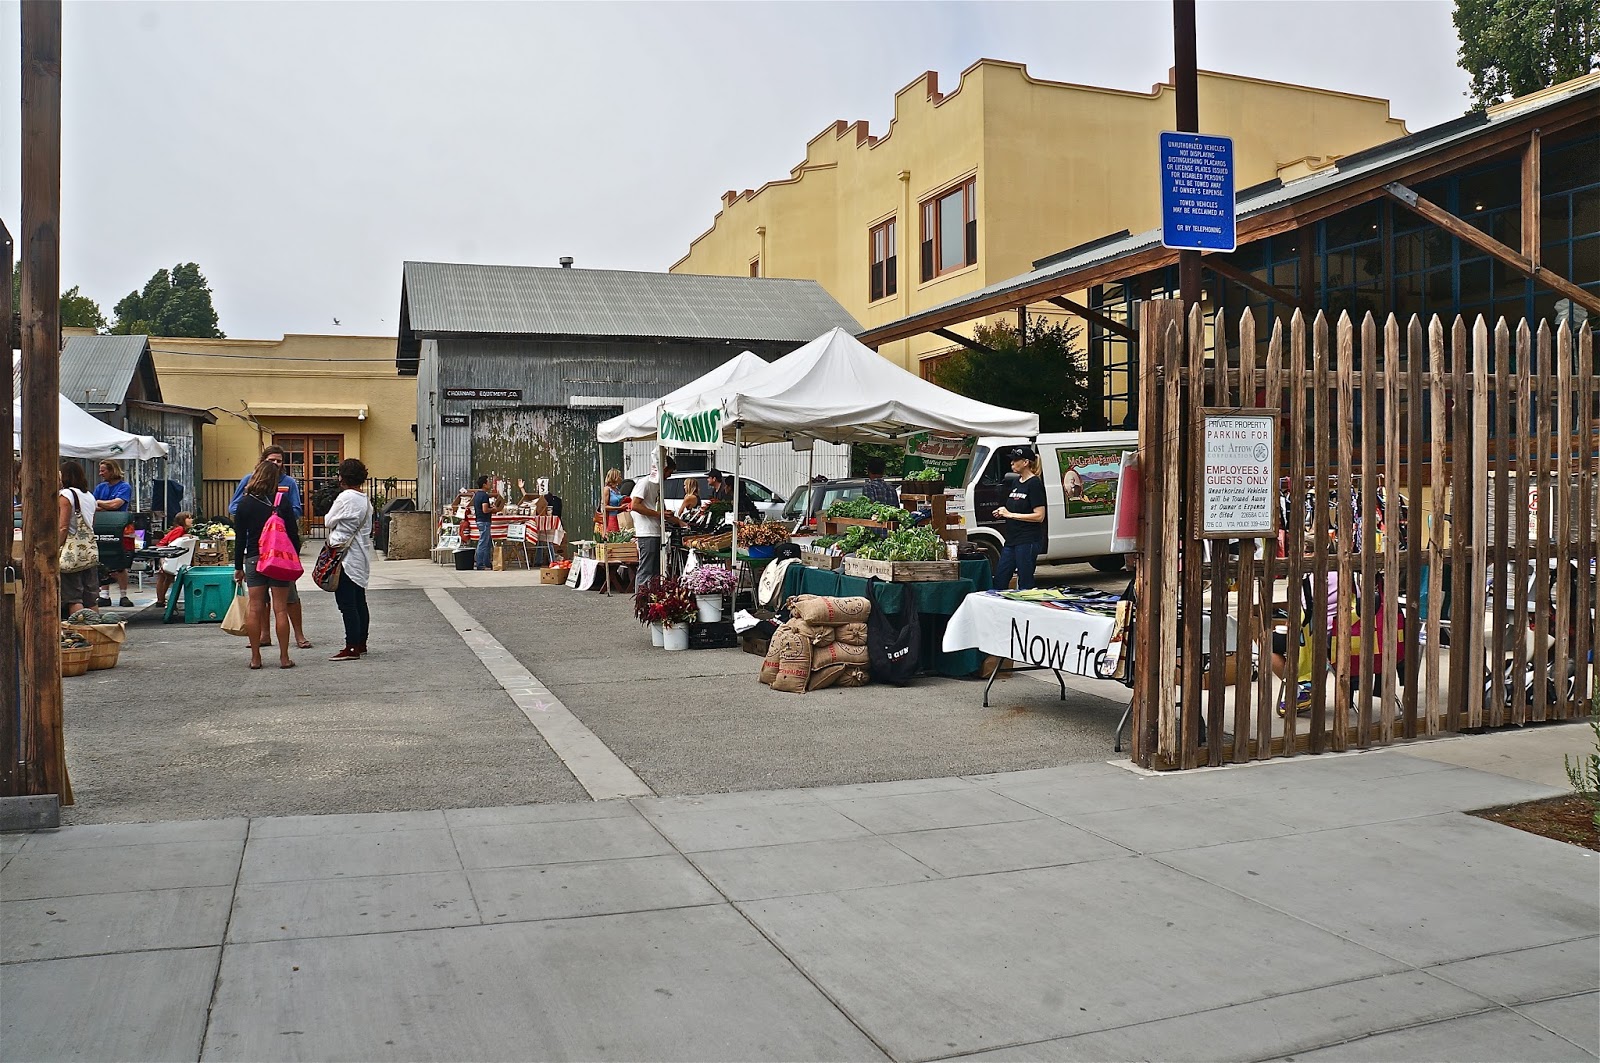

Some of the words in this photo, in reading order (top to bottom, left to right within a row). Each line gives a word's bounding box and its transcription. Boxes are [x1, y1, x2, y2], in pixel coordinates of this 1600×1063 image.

[1168, 141, 1202, 150] UNAUTHORIZED
[1204, 144, 1225, 152] VEHICLES
[1168, 156, 1203, 164] DISTINGUISHING
[1204, 159, 1226, 167] PLACARDS
[1193, 225, 1221, 233] TELEPHONING
[661, 408, 720, 443] ORGANIC
[1207, 431, 1246, 439] PARKING
[1251, 431, 1268, 439] FOR
[1207, 441, 1224, 452] Lost
[1228, 443, 1252, 452] Arrow
[1206, 465, 1259, 474] EMPLOYEES
[1263, 466, 1268, 474] &
[1207, 476, 1242, 484] GUESTS
[1246, 476, 1268, 484] ONLY
[1010, 617, 1069, 670] Now
